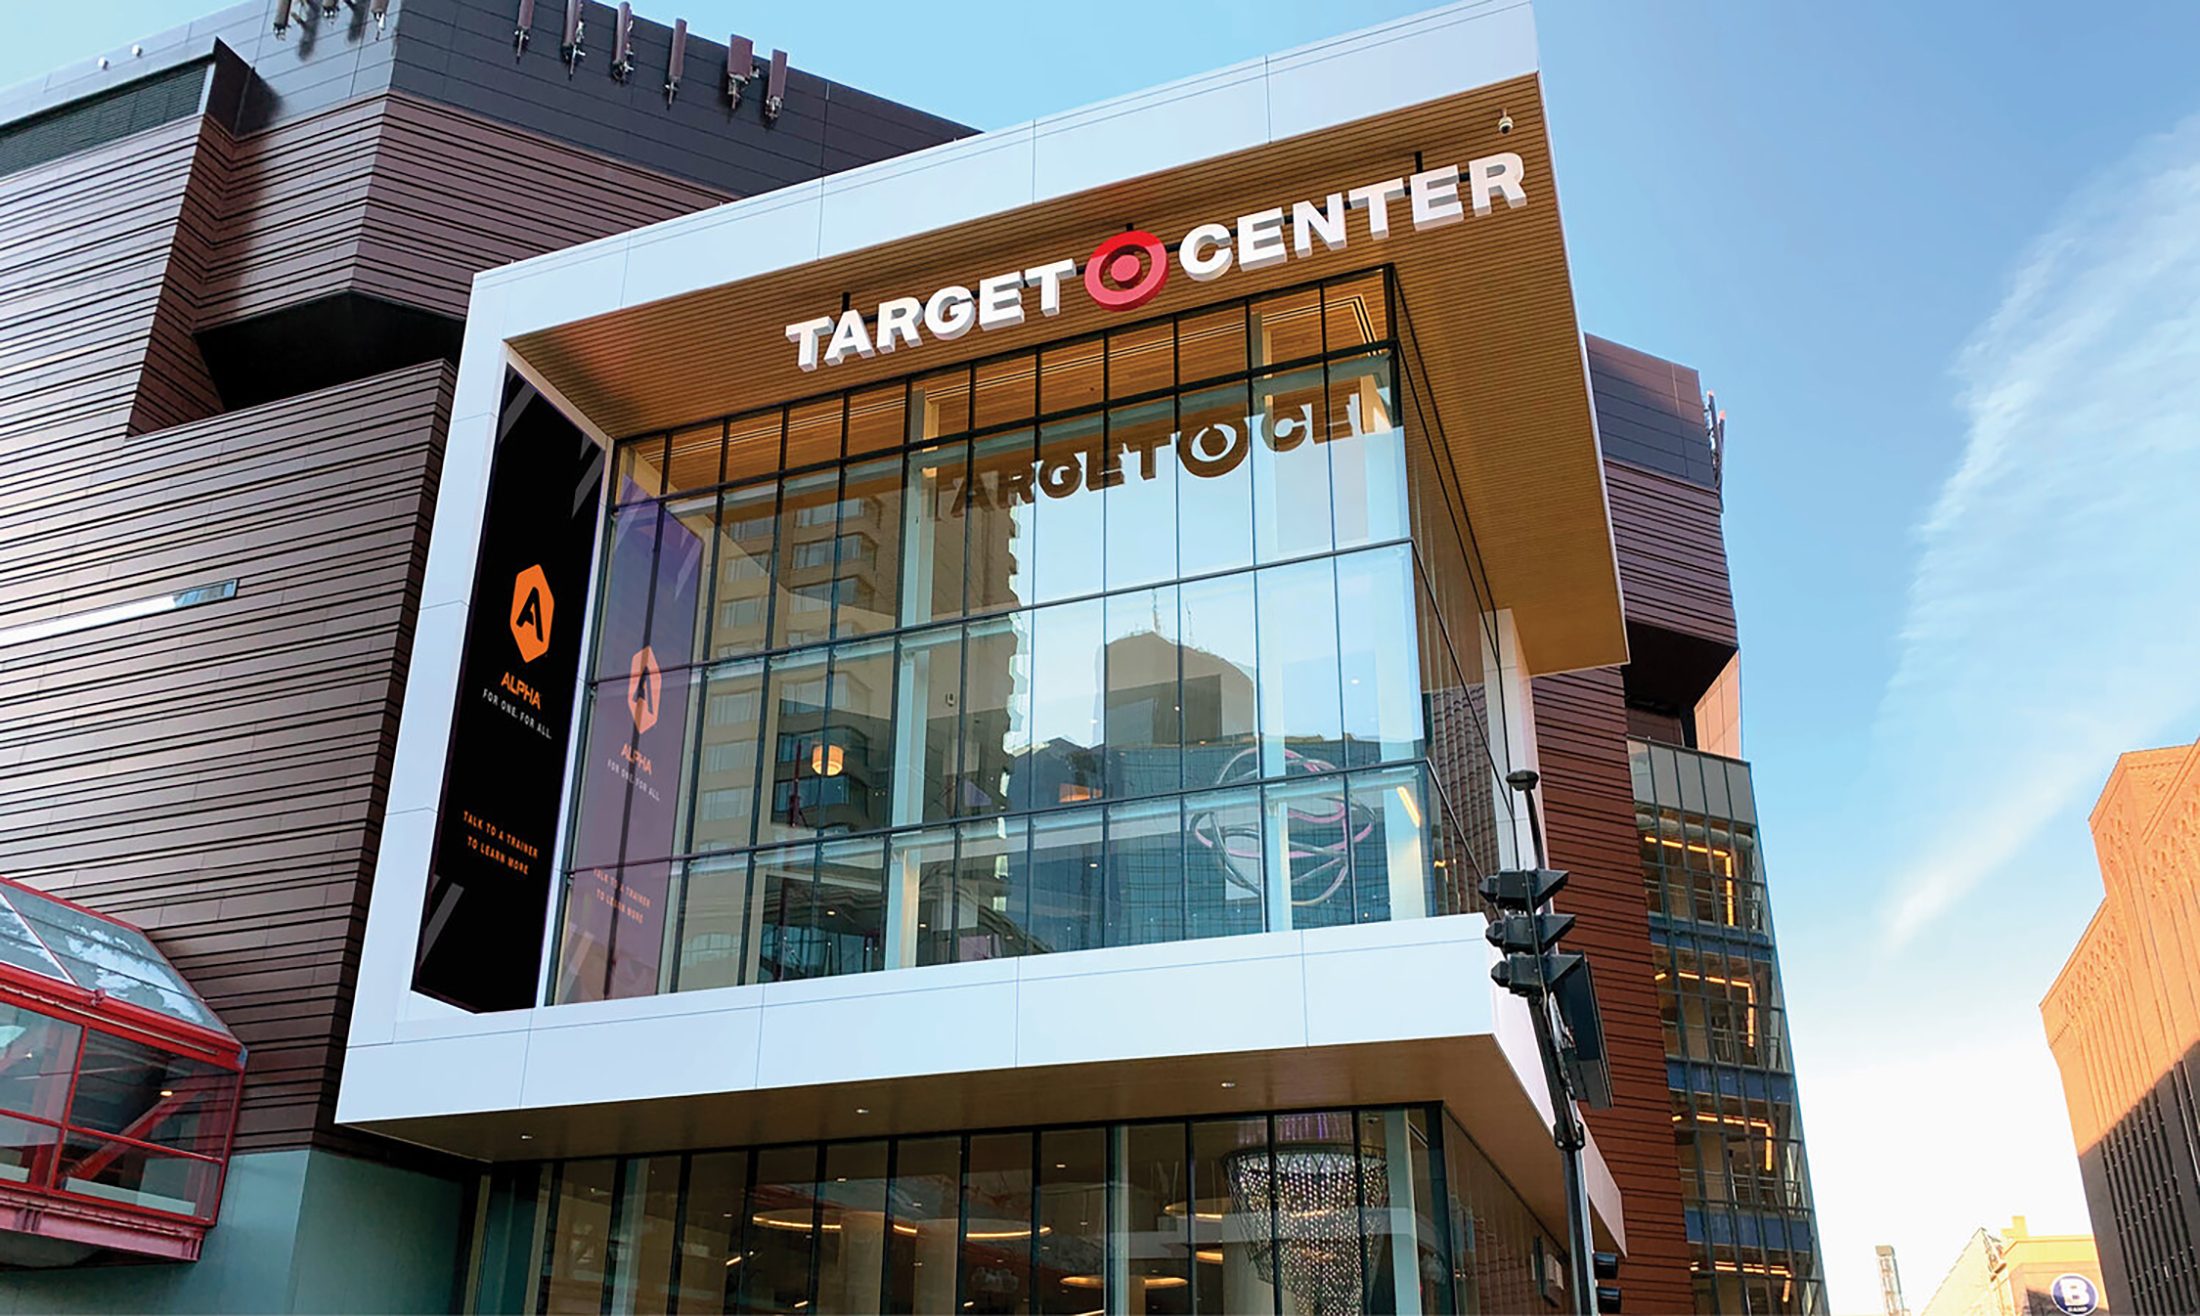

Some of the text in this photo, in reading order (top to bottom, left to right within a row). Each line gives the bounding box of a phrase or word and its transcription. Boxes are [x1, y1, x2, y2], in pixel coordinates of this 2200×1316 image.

[785, 151, 1528, 372] TARGET CENTER
[483, 688, 499, 706] FOR
[520, 712, 535, 728] FOR
[501, 671, 541, 710] ALPHA
[463, 810, 538, 858] TALK TO A TRAINER
[467, 835, 529, 875] TO LEARN MORE
[2060, 1278, 2090, 1306] B
